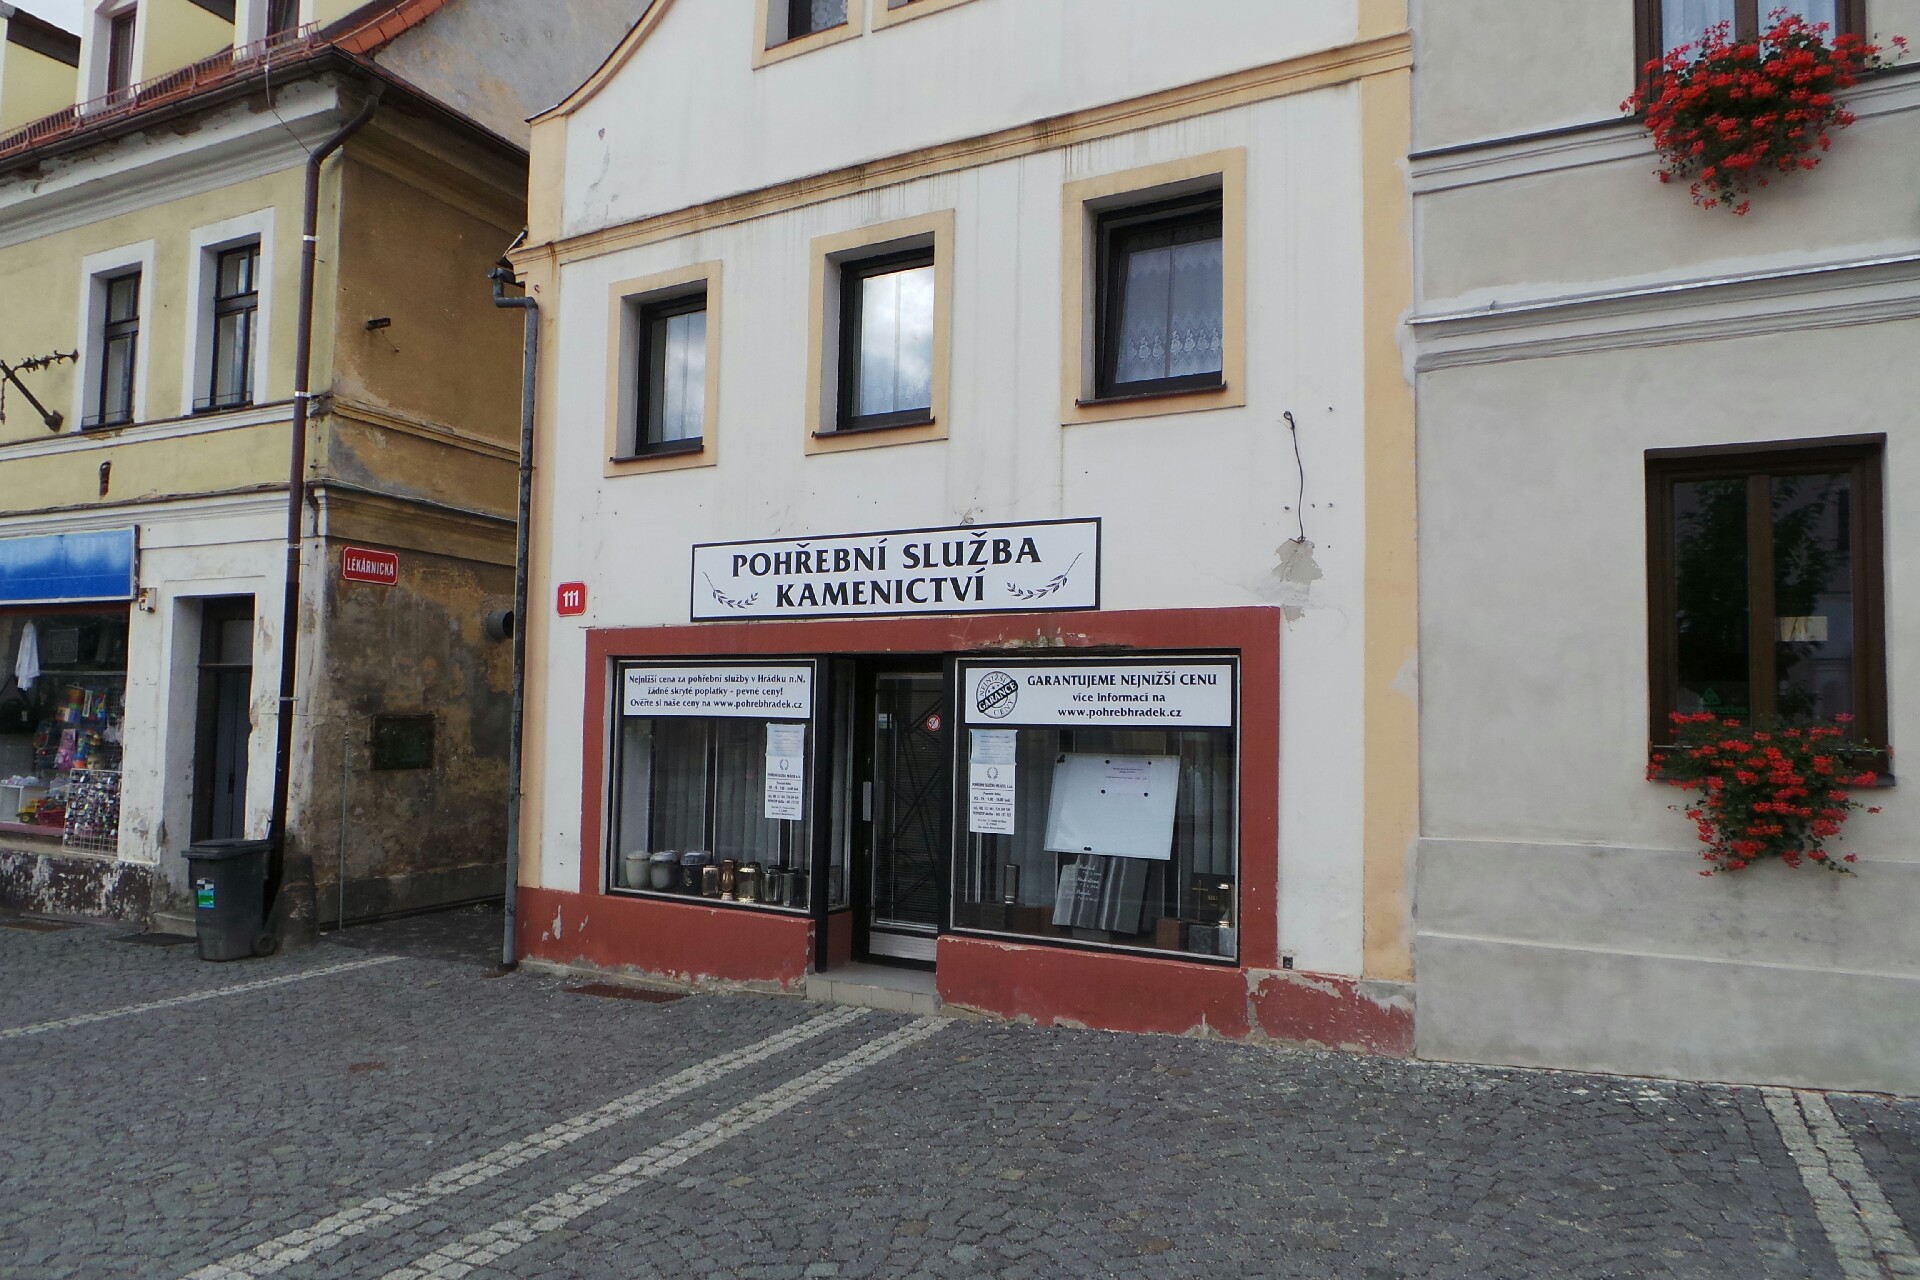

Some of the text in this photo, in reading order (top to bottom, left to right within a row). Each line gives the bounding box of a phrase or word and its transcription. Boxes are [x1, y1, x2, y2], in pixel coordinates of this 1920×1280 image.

[732, 531, 1041, 577] POHŘEBNÍ SLUŽBA
[347, 556, 394, 576] LÉKÁRNICKÁ
[776, 567, 986, 608] KAMENICTVÍ
[562, 590, 579, 607] 111
[688, 674, 722, 686] pohřební
[724, 674, 749, 685] služby
[757, 674, 787, 683] Hrádku
[1027, 671, 1217, 687] GARANTUJEME NEJNIŽŠÍ CENU
[694, 686, 728, 697] poplatky
[736, 686, 759, 696] pevné
[762, 687, 784, 697] ceny!
[978, 681, 1017, 711] GARANCE
[1072, 692, 1166, 702] více informací na
[663, 698, 681, 707] naše
[682, 700, 700, 709] ceny
[713, 700, 803, 710] www.pohrebhradek.cz
[1058, 707, 1182, 719] www.pohrebhradek.cz
